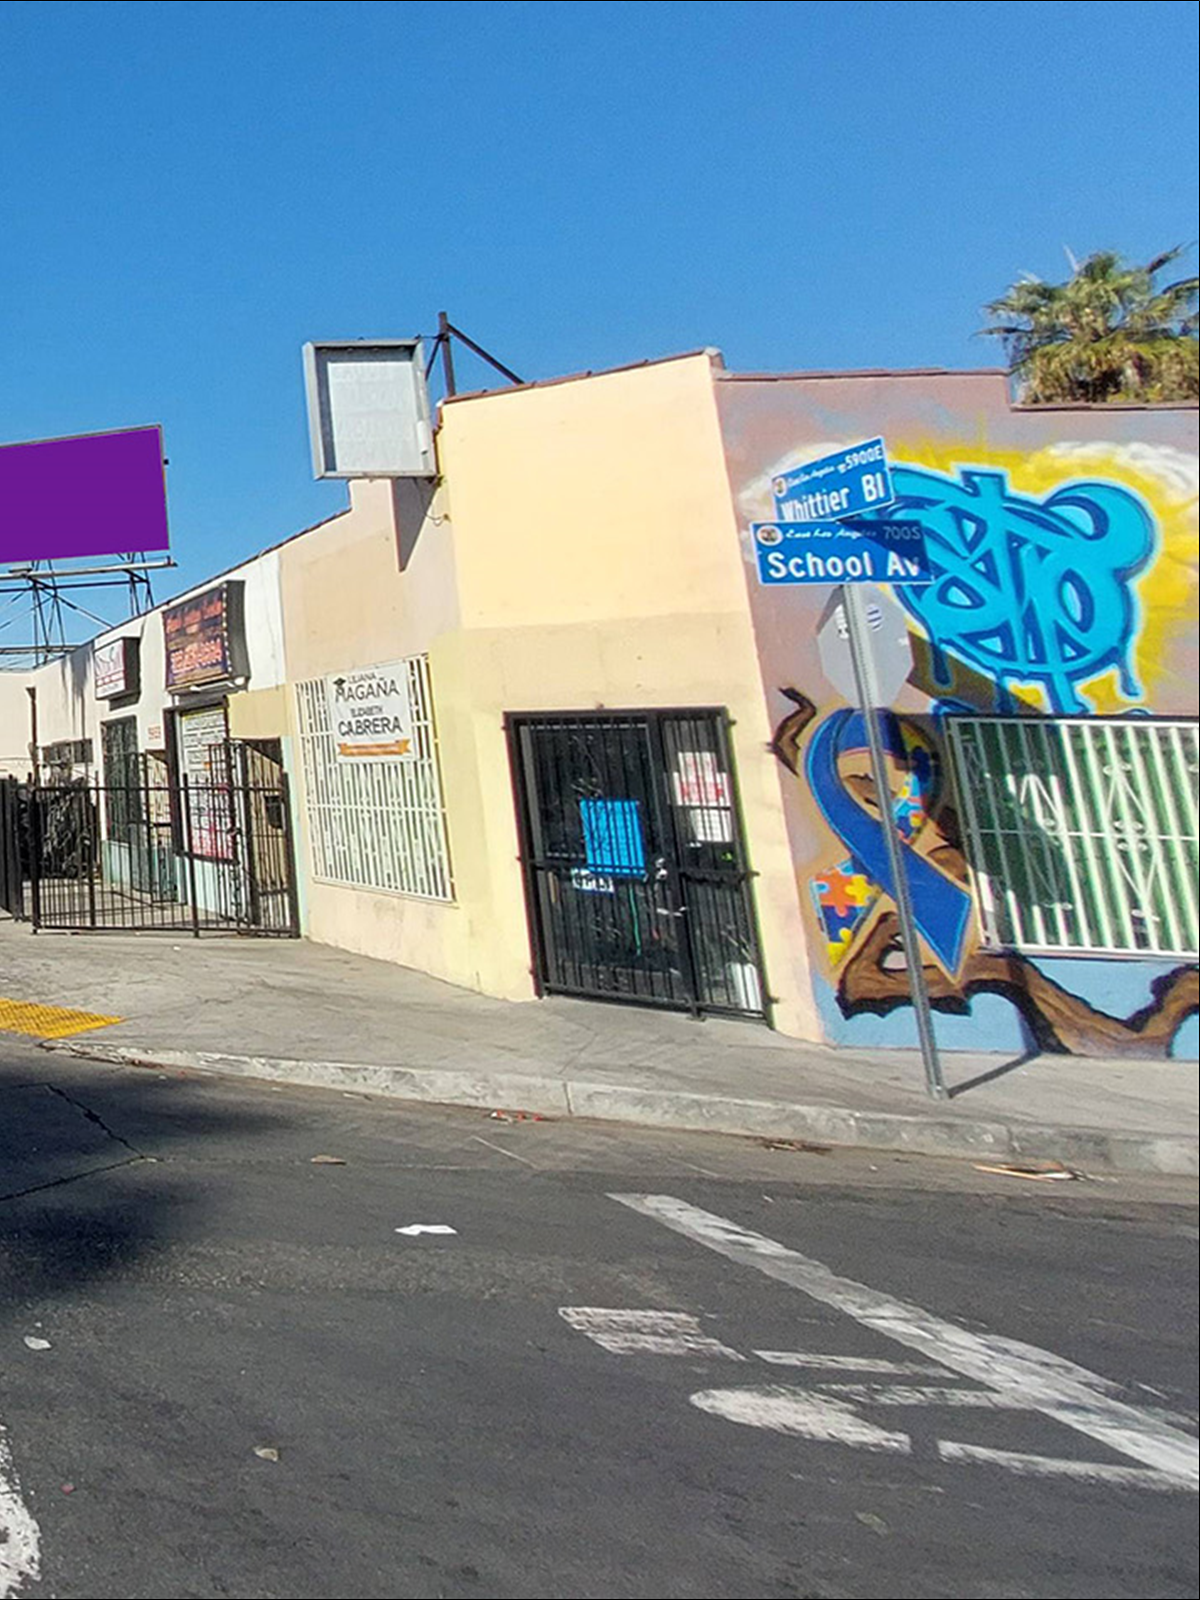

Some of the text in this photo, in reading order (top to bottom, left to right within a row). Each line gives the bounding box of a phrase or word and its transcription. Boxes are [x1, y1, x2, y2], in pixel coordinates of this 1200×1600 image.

[845, 445, 883, 470] 5900E
[781, 472, 885, 520] Whittier Bl
[882, 525, 921, 540] 700S
[767, 550, 919, 578] School Av
[338, 715, 404, 737] CABRERA
